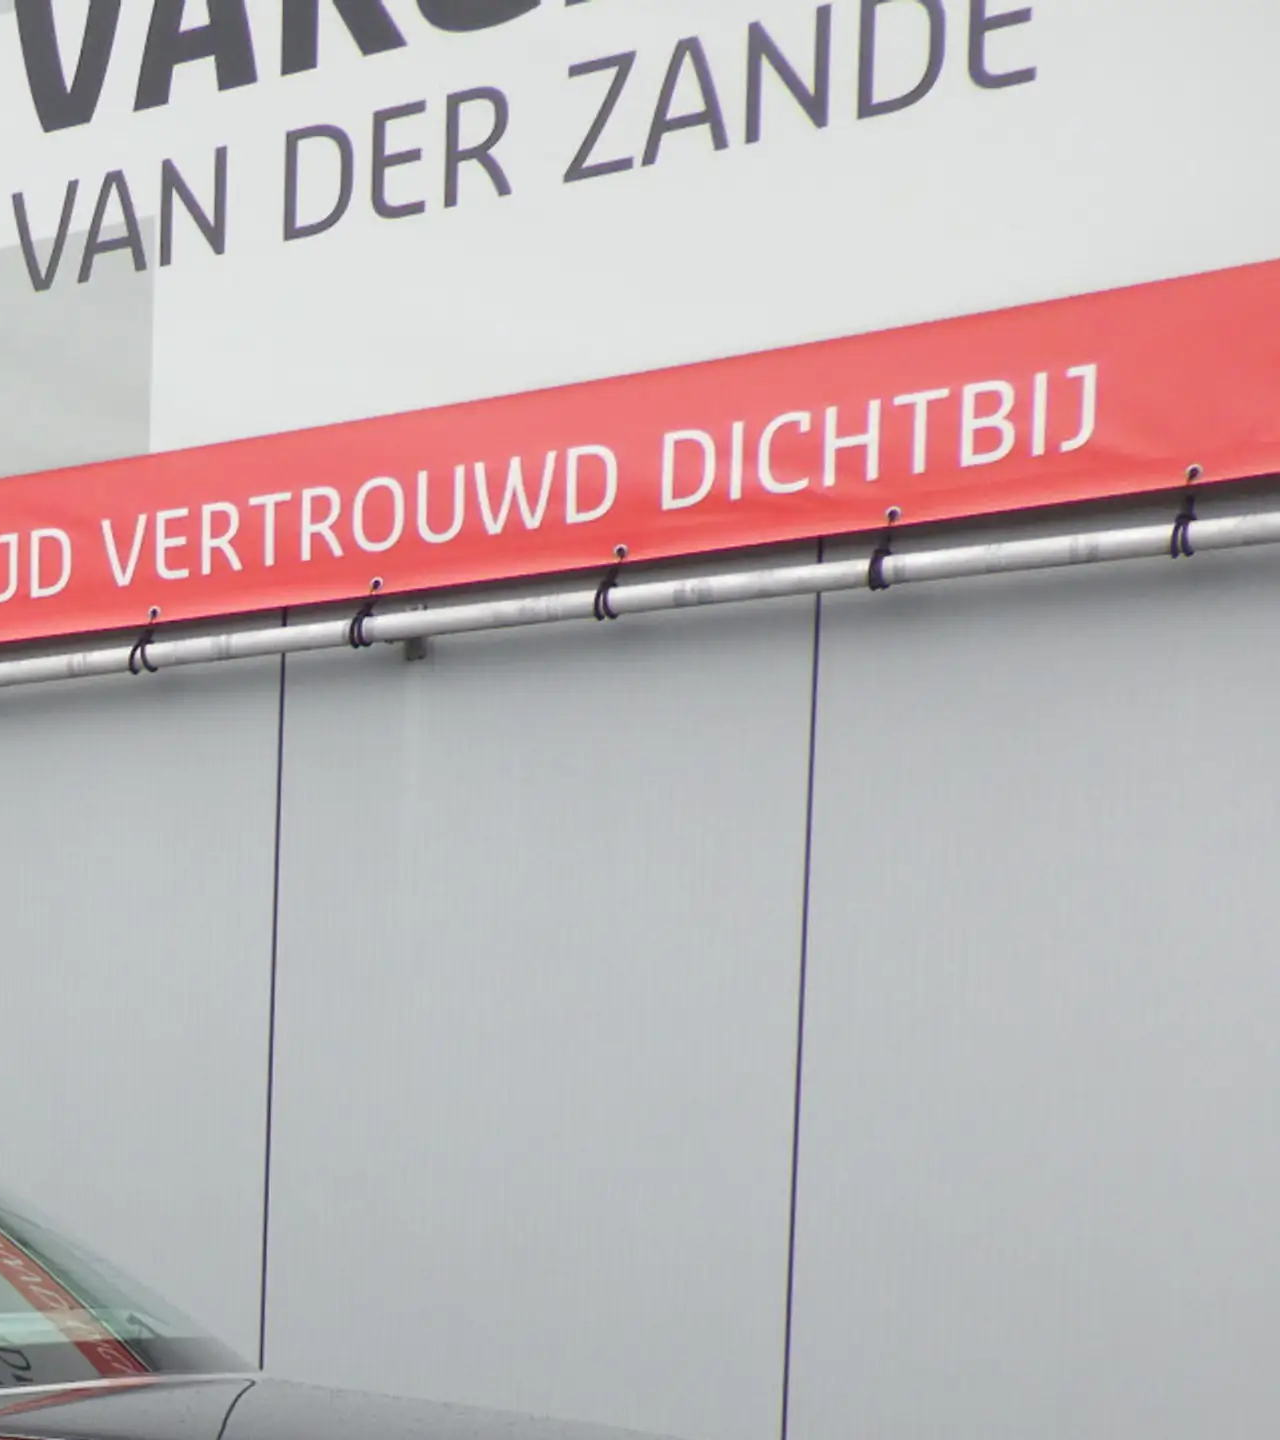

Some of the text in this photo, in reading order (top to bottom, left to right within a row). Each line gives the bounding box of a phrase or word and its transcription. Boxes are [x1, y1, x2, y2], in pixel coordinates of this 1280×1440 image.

[11, 0, 1037, 293] VAN DER ZANDE
[101, 444, 619, 587] VERTROUWD
[661, 363, 1099, 512] DICHTBIJ
